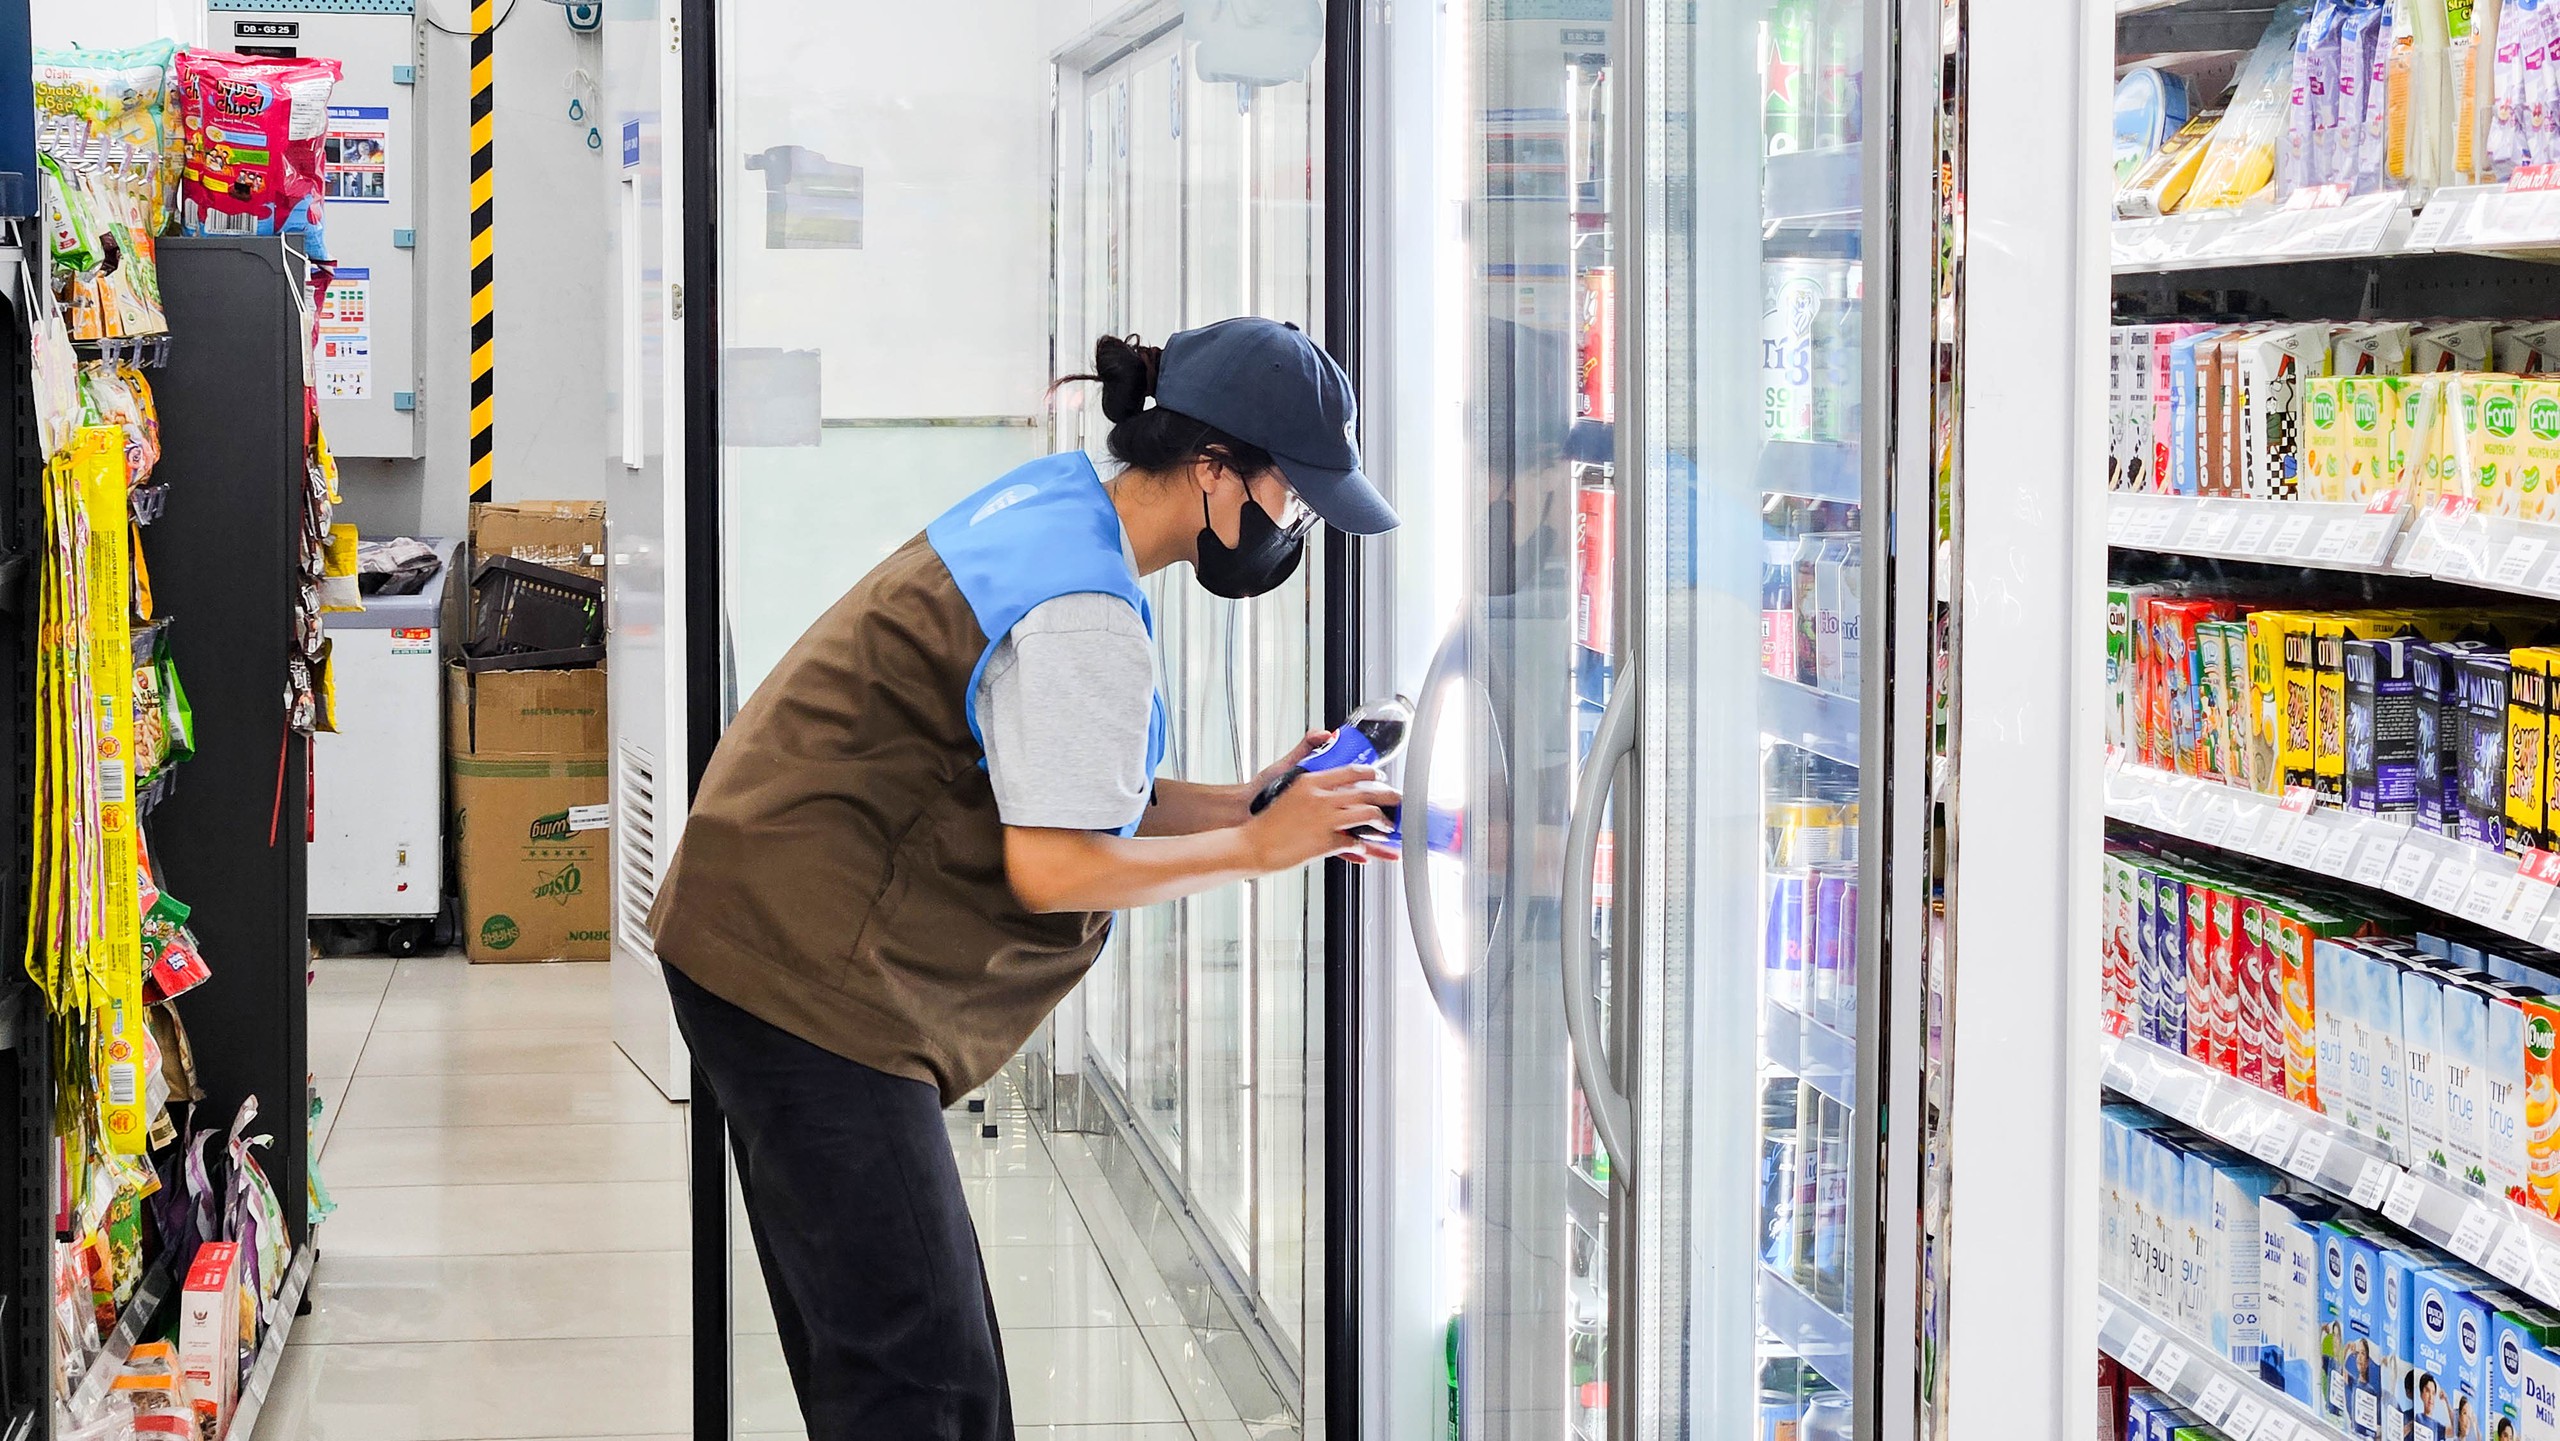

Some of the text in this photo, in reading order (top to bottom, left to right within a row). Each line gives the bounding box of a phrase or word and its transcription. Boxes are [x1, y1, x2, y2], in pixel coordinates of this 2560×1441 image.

[243, 25, 257, 33] DB
[263, 25, 277, 34] GS
[277, 26, 290, 34] 25
[44, 67, 72, 80] Oishi
[37, 81, 83, 98] Snack
[2469, 674, 2505, 711] MALTO
[2511, 671, 2546, 708] MALTO
[2408, 1050, 2426, 1073] TH
[2409, 1071, 2435, 1105] true
[2448, 1064, 2464, 1088] TH
[2447, 1085, 2473, 1121] true
[2490, 1080, 2506, 1105] TH
[2488, 1102, 2515, 1139] true
[2525, 1376, 2556, 1409] Dalat
[2535, 1403, 2555, 1428] Milk
